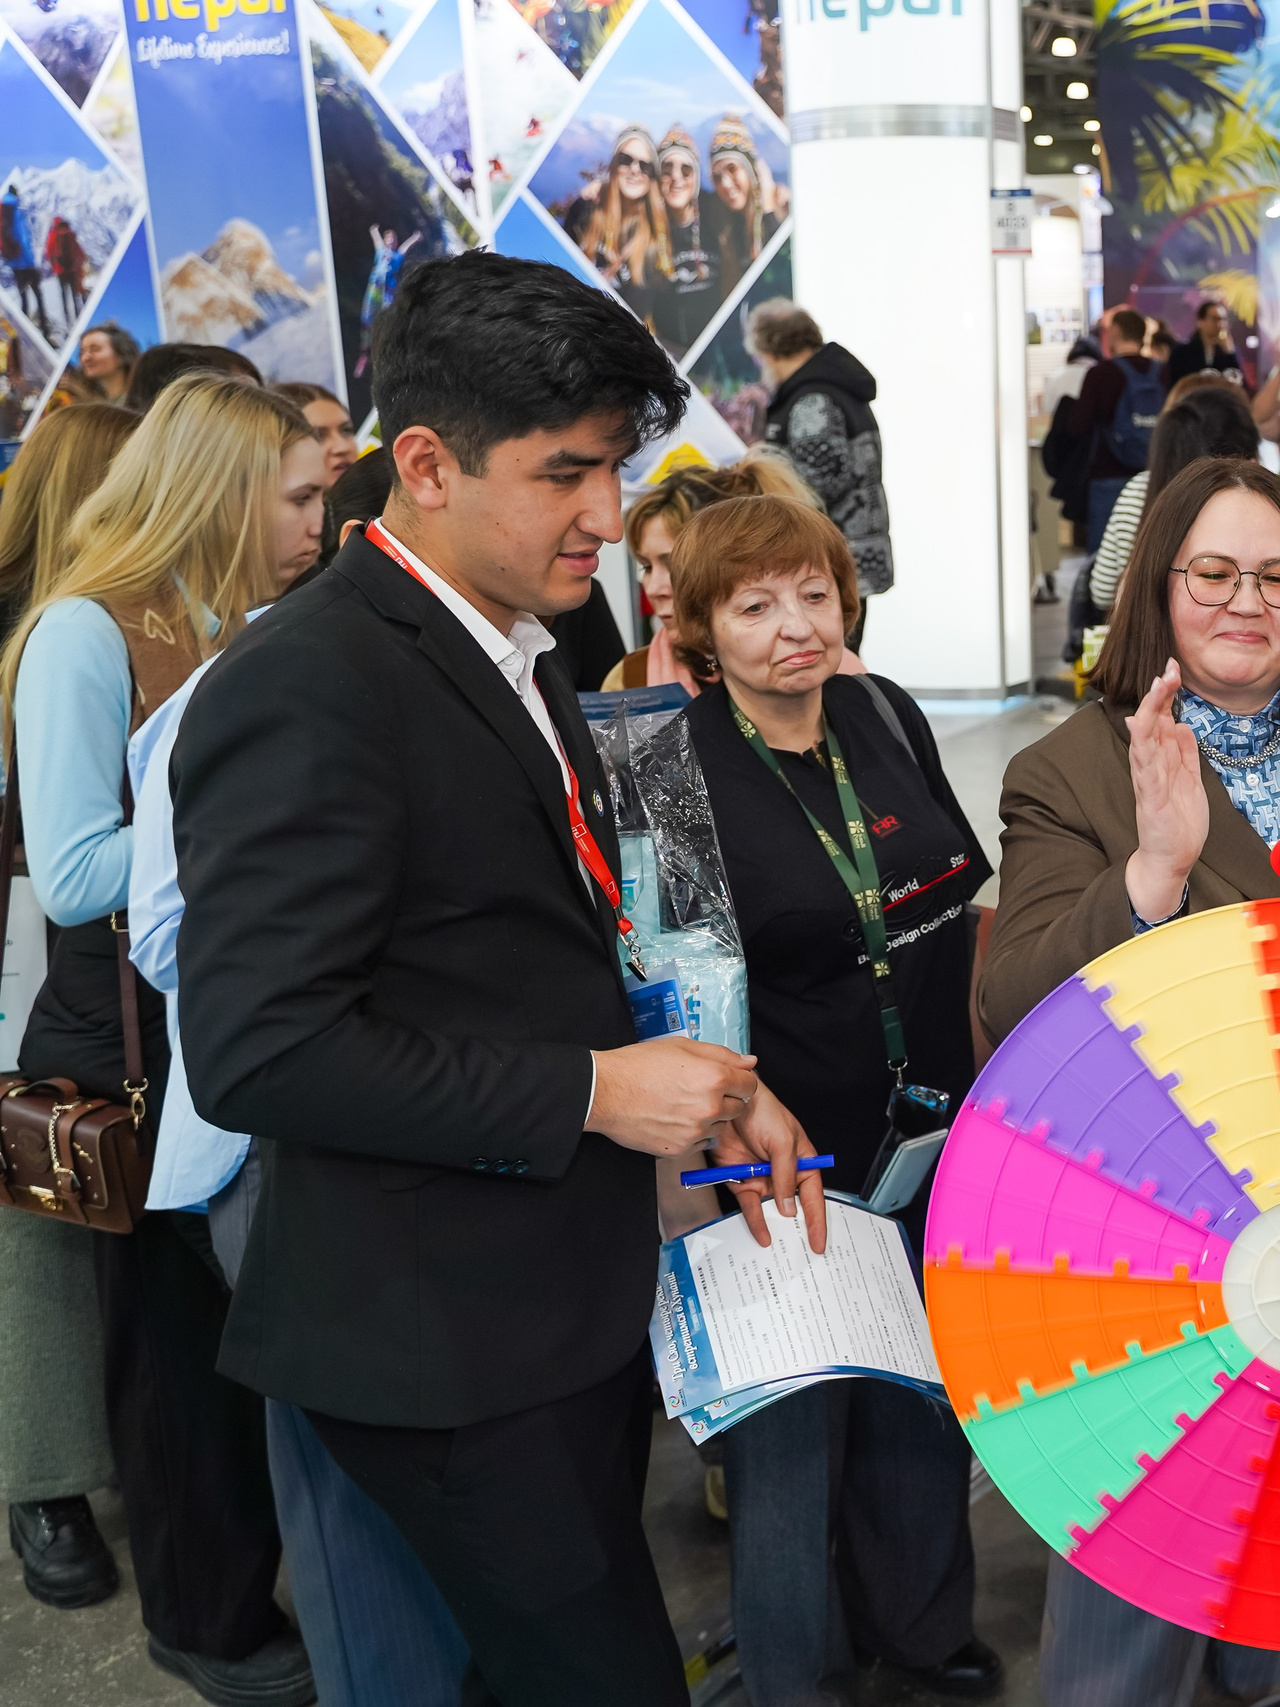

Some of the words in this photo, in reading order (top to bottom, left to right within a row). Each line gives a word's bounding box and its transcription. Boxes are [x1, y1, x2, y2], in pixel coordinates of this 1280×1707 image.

[888, 878, 919, 902] World
[950, 853, 965, 868] Star
[886, 928, 921, 952] Design
[920, 903, 963, 934] Collection
[656, 1285, 669, 1306] реки
[664, 1271, 684, 1308] Хунани!
[659, 1306, 673, 1341] четыре
[677, 1312, 698, 1371] встретимся
[668, 1340, 681, 1363] Сяо,
[671, 1362, 686, 1382] Три
